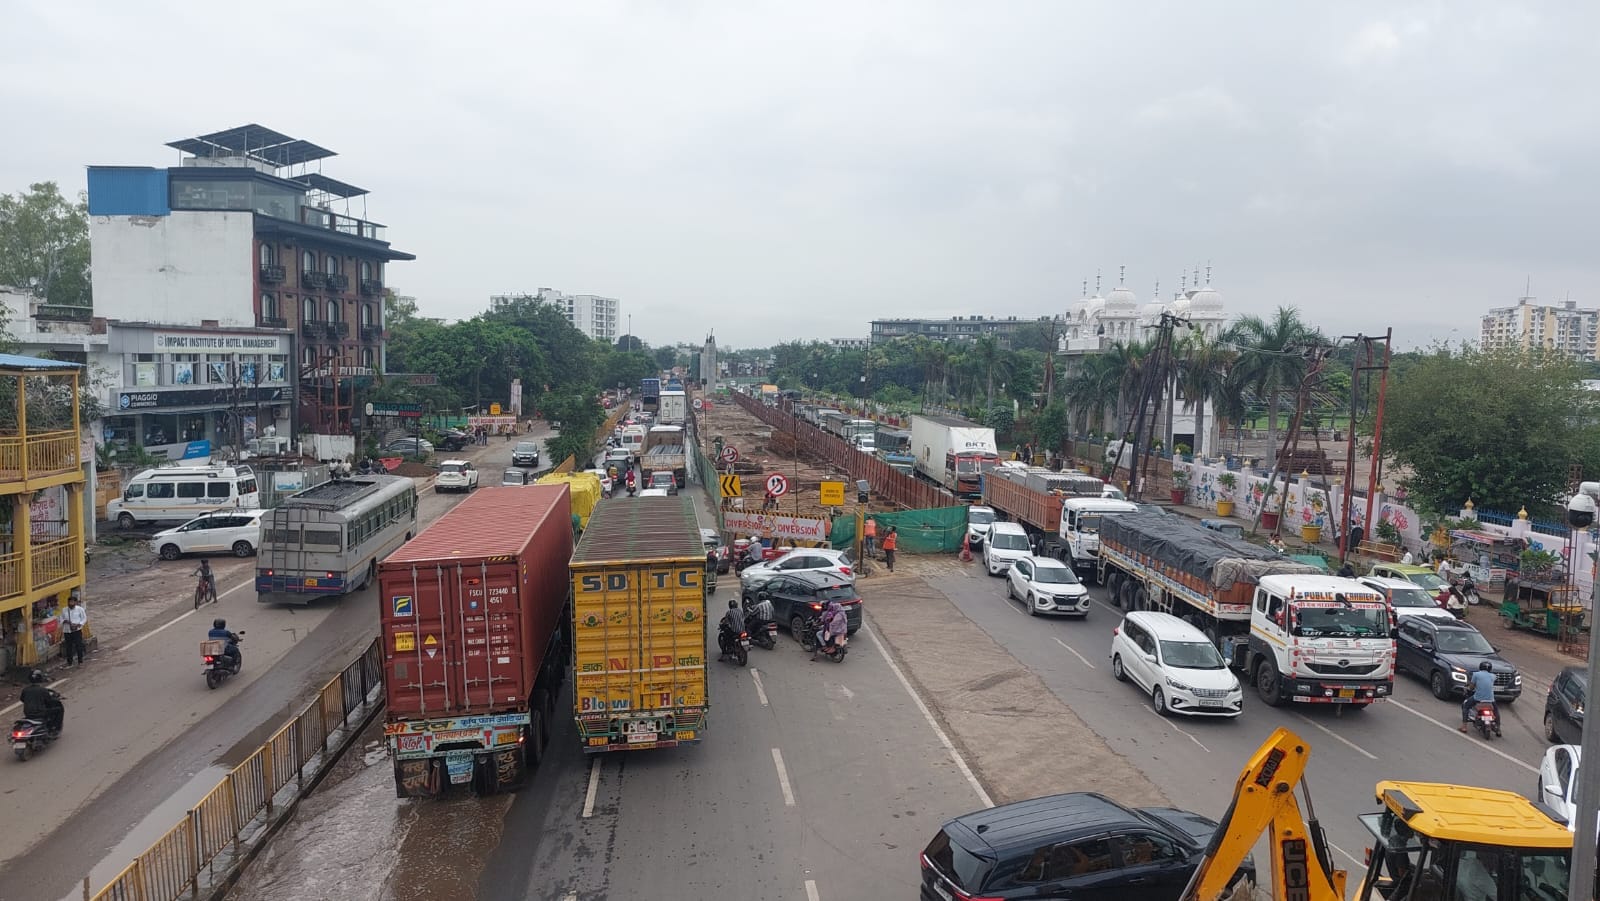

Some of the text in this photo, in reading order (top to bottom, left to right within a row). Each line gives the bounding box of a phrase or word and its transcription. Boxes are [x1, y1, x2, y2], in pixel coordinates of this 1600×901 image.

[189, 337, 217, 347] INSTITUTE
[218, 338, 225, 347] OF
[226, 338, 242, 348] HOTEL
[242, 339, 277, 348] MANAGEMENT
[130, 393, 158, 402] PIAGGIO
[777, 524, 818, 535] DIVERSION
[1304, 592, 1334, 600] PUBLIC
[609, 657, 629, 671] N
[653, 655, 673, 669] P
